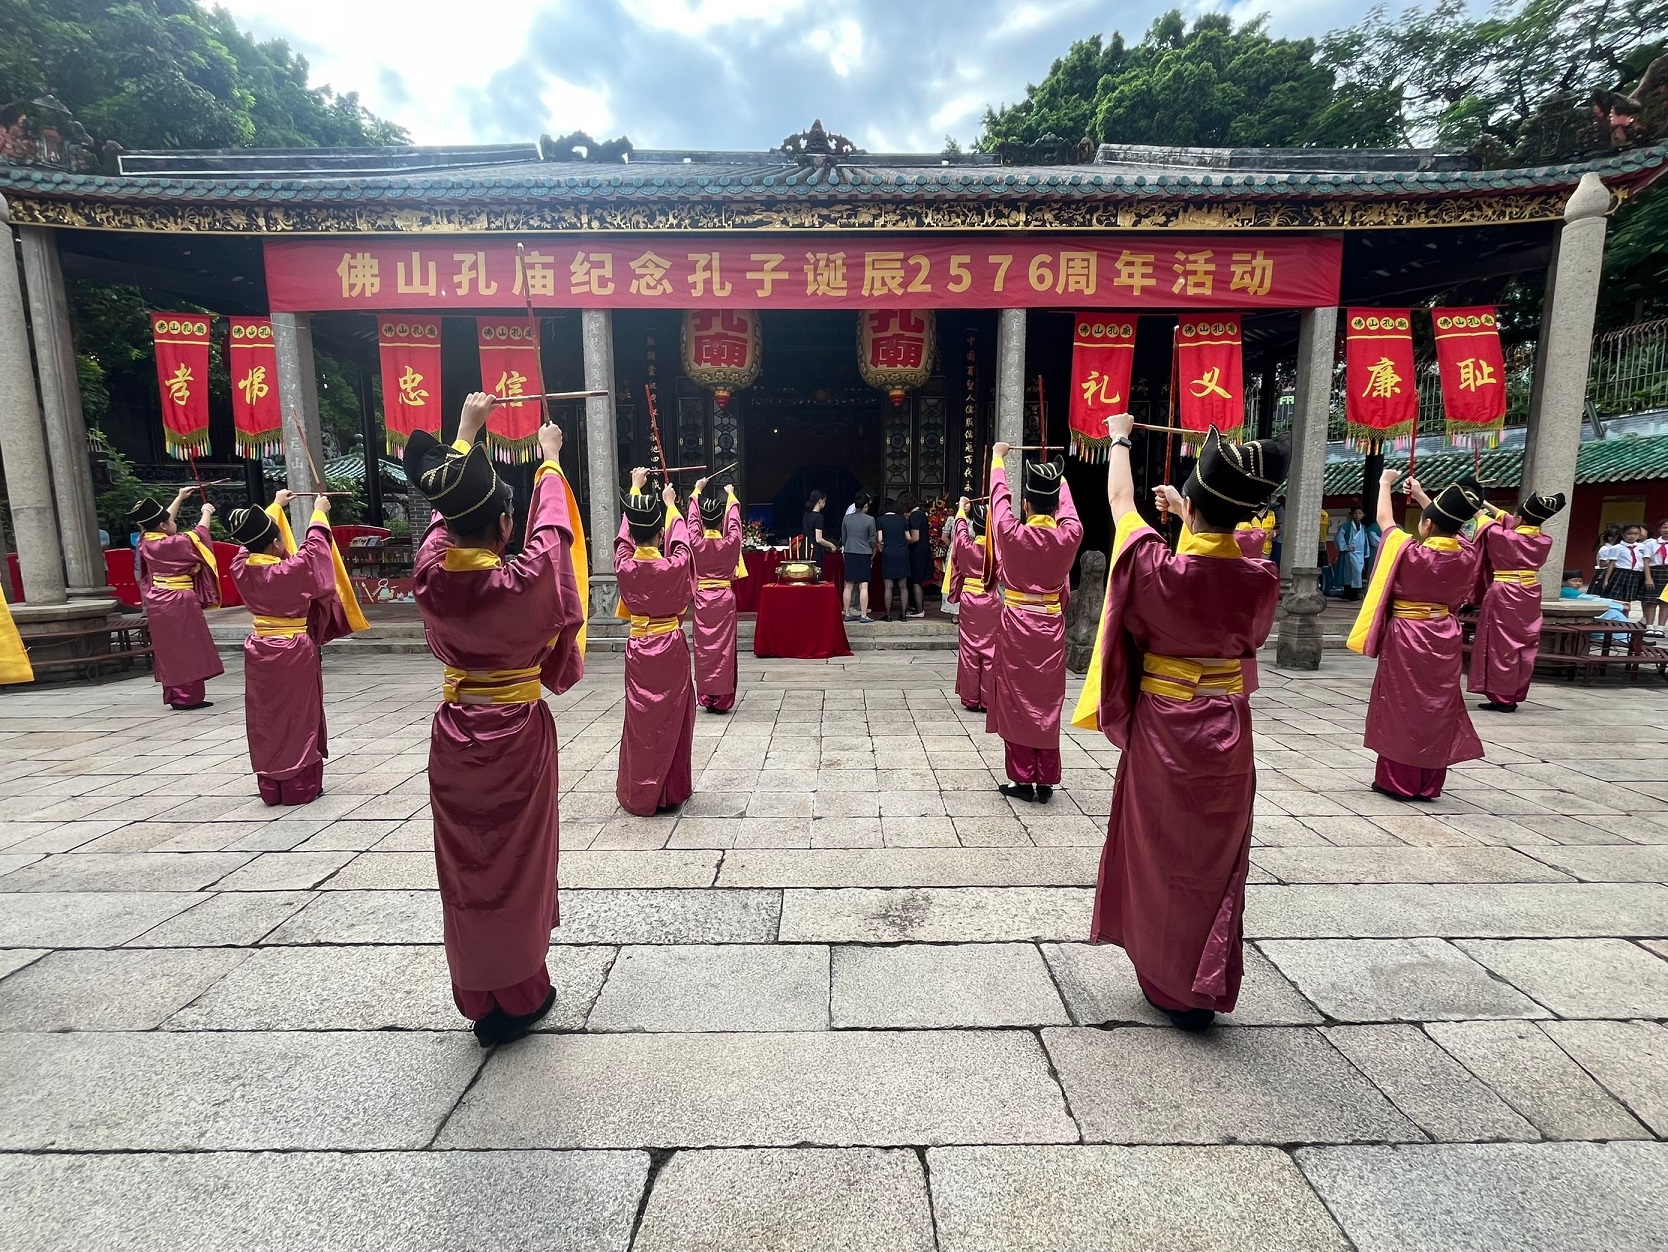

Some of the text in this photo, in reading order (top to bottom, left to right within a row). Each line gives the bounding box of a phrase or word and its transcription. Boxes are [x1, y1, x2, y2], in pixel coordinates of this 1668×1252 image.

[336, 250, 1274, 298] 佛山孔庙纪念孔子诞辰2576周年活动
[233, 326, 272, 338] 佛山孔
[383, 324, 437, 338] 佛山孔廟
[1079, 323, 1132, 336] 佛山孔廟
[165, 362, 194, 406] 孝
[238, 366, 269, 406] 悌
[398, 365, 430, 406] 忠
[495, 370, 528, 408] 信
[1081, 370, 1121, 406] 礼
[1189, 366, 1233, 399] 义
[1362, 357, 1403, 398] 廉
[1456, 358, 1497, 393] 耻
